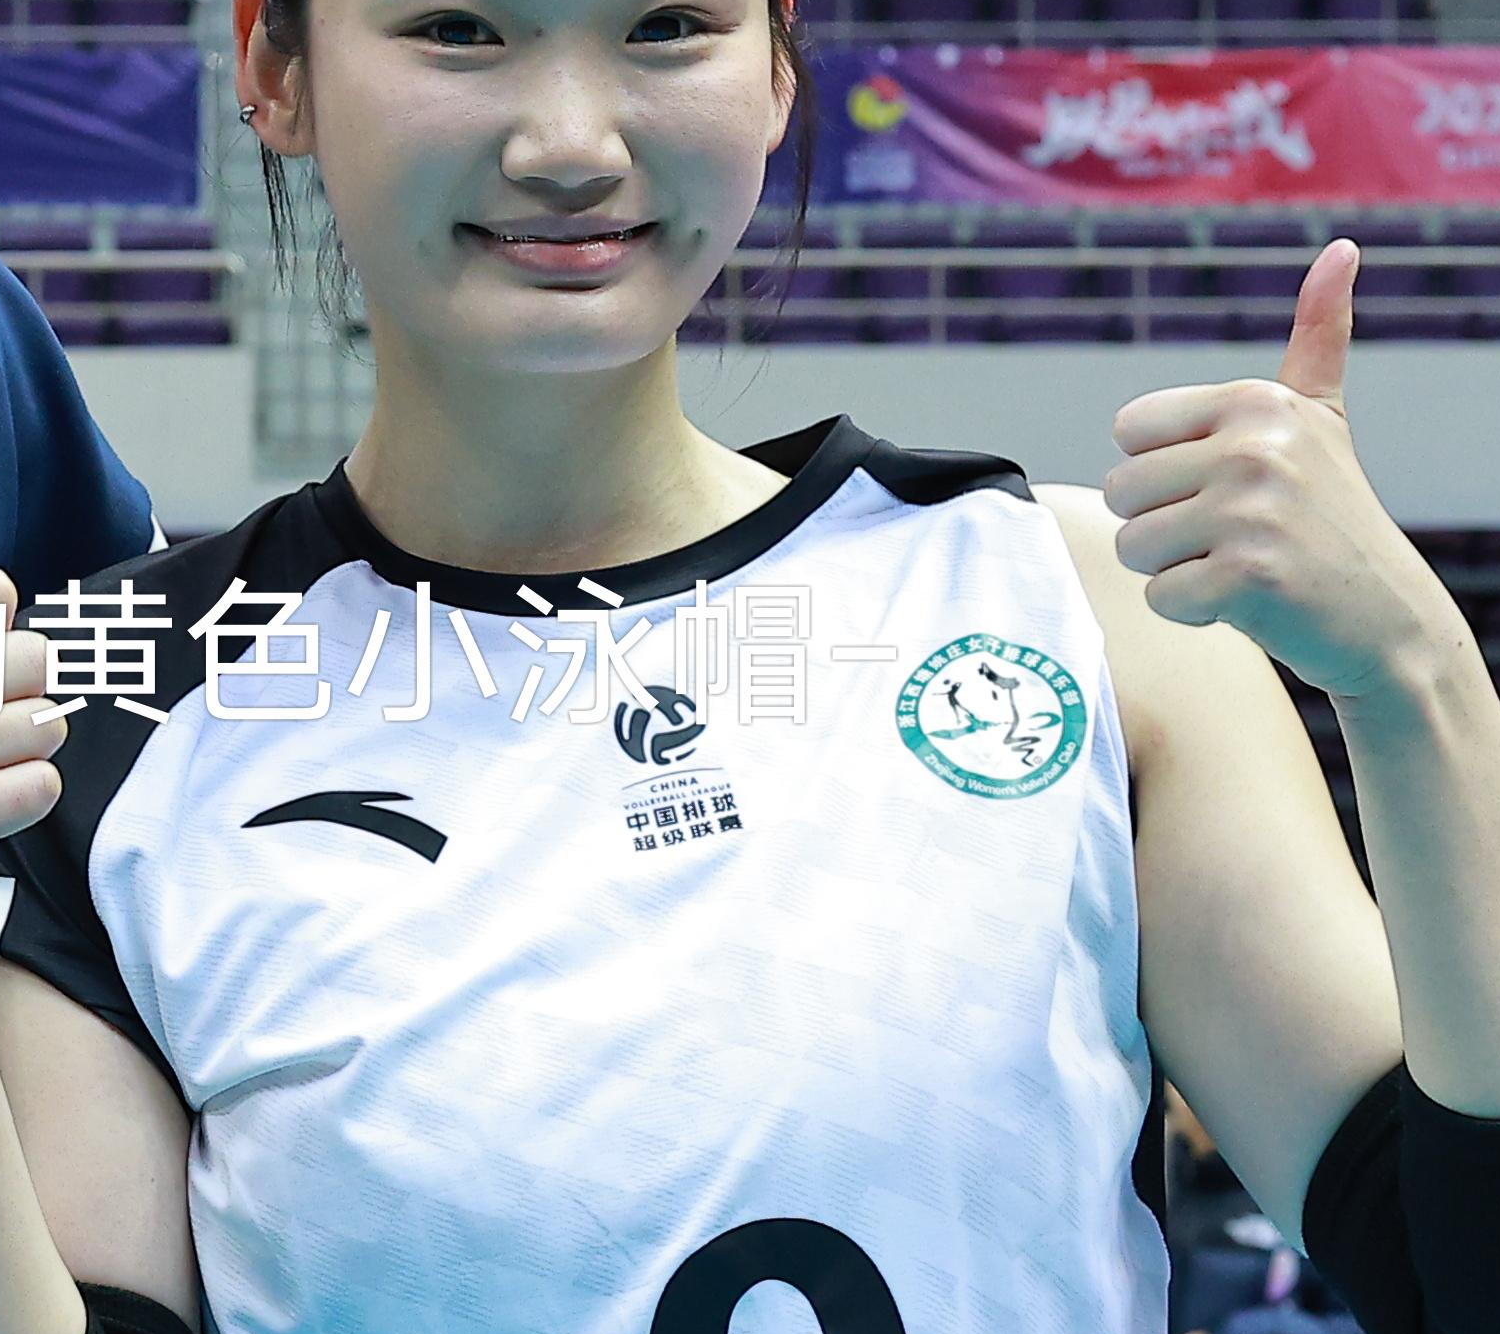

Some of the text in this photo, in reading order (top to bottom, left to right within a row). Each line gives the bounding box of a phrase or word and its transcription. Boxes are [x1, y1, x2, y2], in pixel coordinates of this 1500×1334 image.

[1058, 741, 1077, 767] Club
[624, 783, 731, 810] VOLLEYBALL LEAGUE
[650, 777, 698, 793] CHINA
[626, 793, 737, 832] 中国排球
[633, 814, 744, 852] 超级联赛
